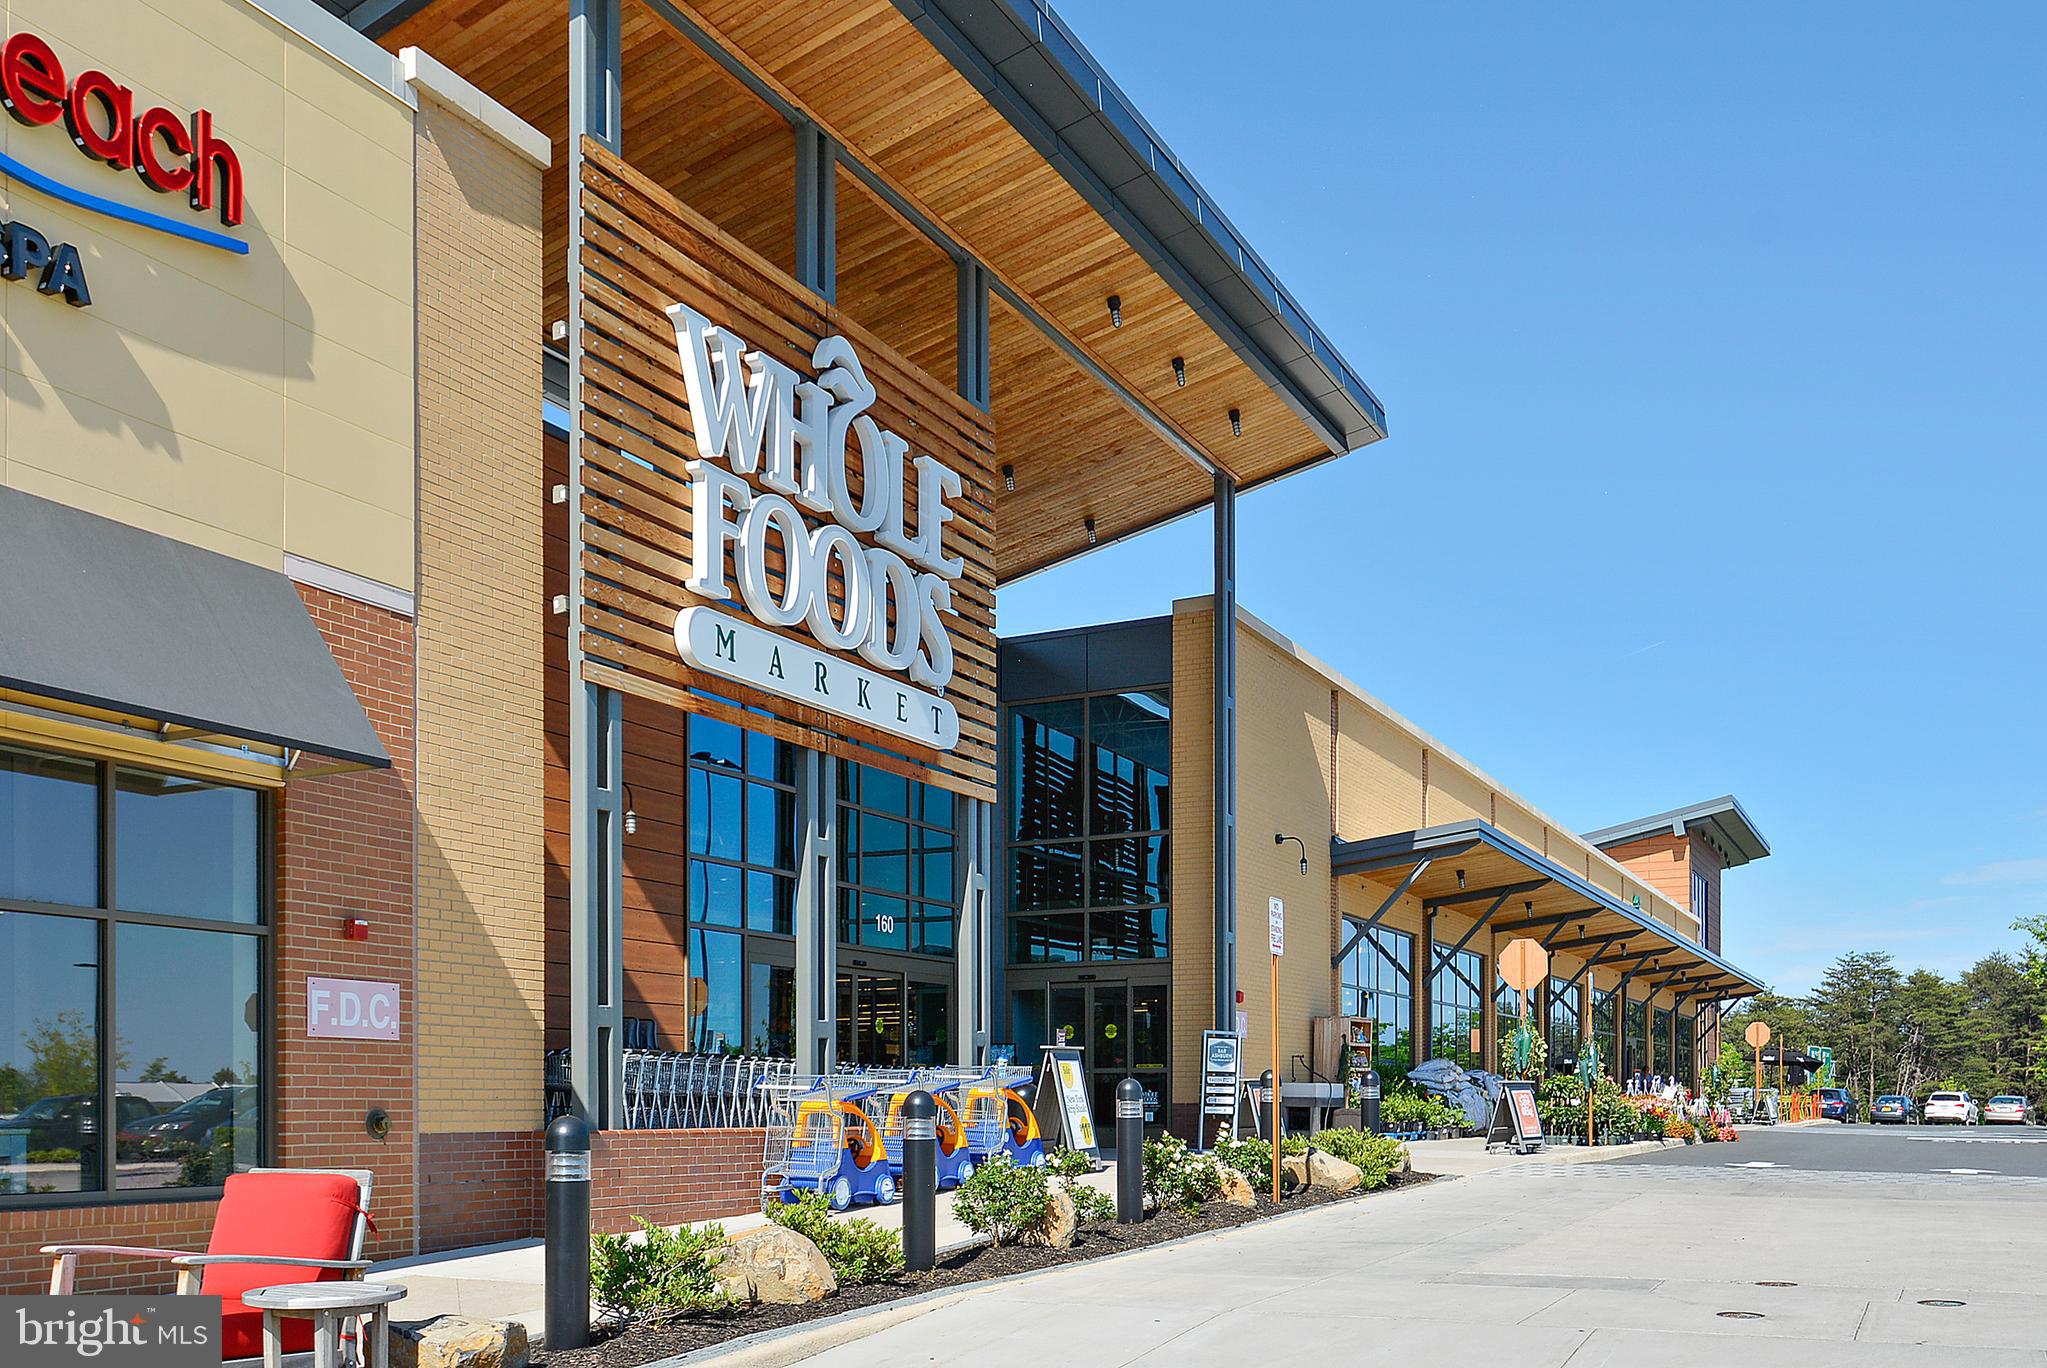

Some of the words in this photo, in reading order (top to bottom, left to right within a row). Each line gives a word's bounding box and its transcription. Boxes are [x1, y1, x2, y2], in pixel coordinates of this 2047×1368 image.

[665, 303, 963, 579] WHOLE
[685, 459, 954, 688] FOODS
[715, 622, 943, 735] MARKET
[875, 913, 894, 934] 160
[311, 989, 397, 1030] F.D.C.
